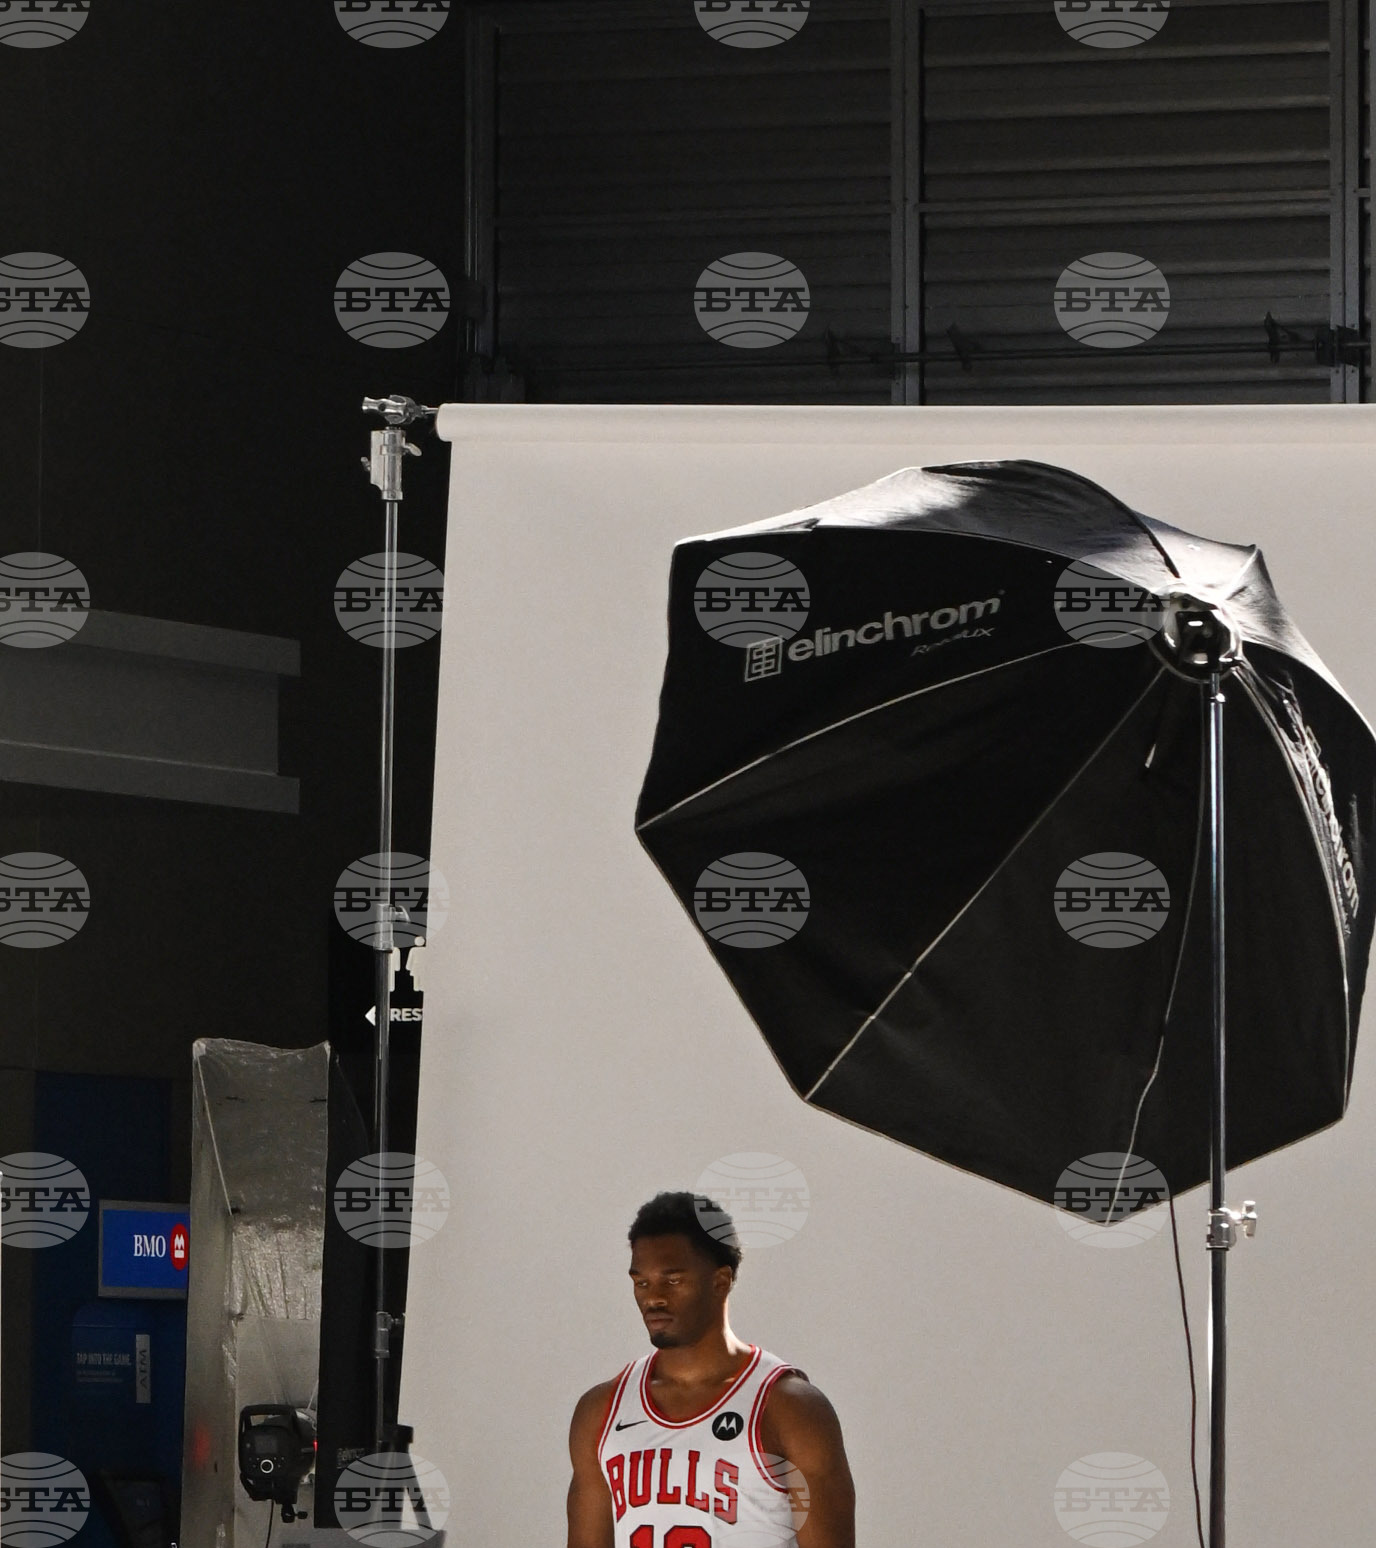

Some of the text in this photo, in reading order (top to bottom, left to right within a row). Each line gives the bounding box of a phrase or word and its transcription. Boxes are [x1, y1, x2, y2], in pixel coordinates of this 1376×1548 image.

[788, 597, 1001, 661] elinchrom
[390, 1007, 424, 1022] RES
[133, 1234, 167, 1258] BMO
[605, 1447, 740, 1525] BULLS
